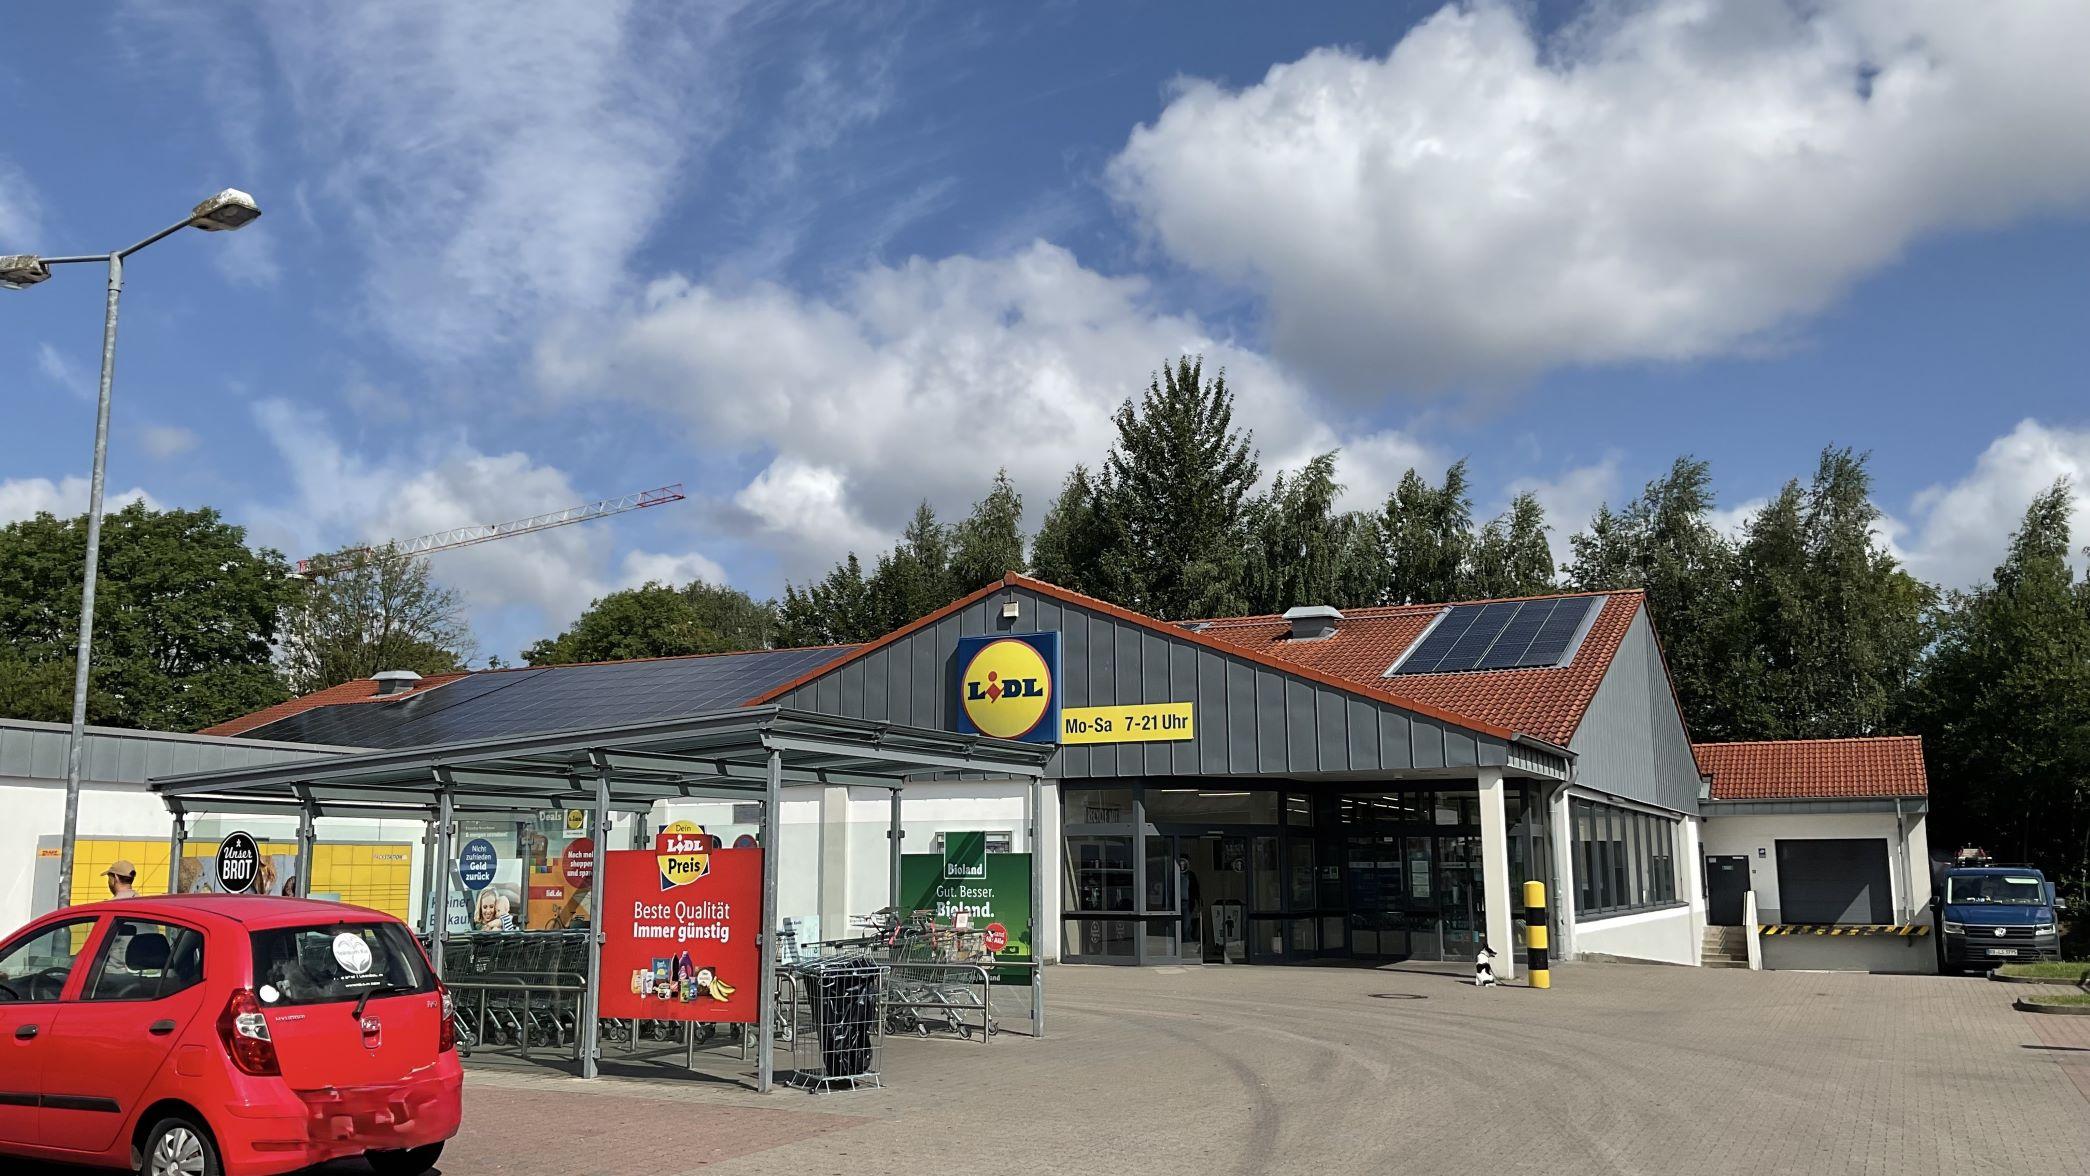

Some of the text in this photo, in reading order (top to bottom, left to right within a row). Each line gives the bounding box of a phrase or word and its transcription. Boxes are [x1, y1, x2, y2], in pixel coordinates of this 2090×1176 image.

[1065, 714, 1188, 734] Mo-Sa 7-21 Uhr
[540, 811, 562, 821] Deals
[675, 824, 692, 832] Dein
[223, 846, 253, 859] Unser
[465, 854, 492, 862] zufrieden
[222, 859, 253, 880] BROT
[469, 862, 487, 871] Geld
[668, 857, 701, 874] Preis
[947, 863, 983, 875] Bioland
[465, 871, 490, 881] zurück
[567, 869, 579, 877] und
[936, 885, 995, 898] Gut. Besser.
[634, 900, 730, 923] Beste Qualität
[633, 921, 730, 943] Immer günstig
